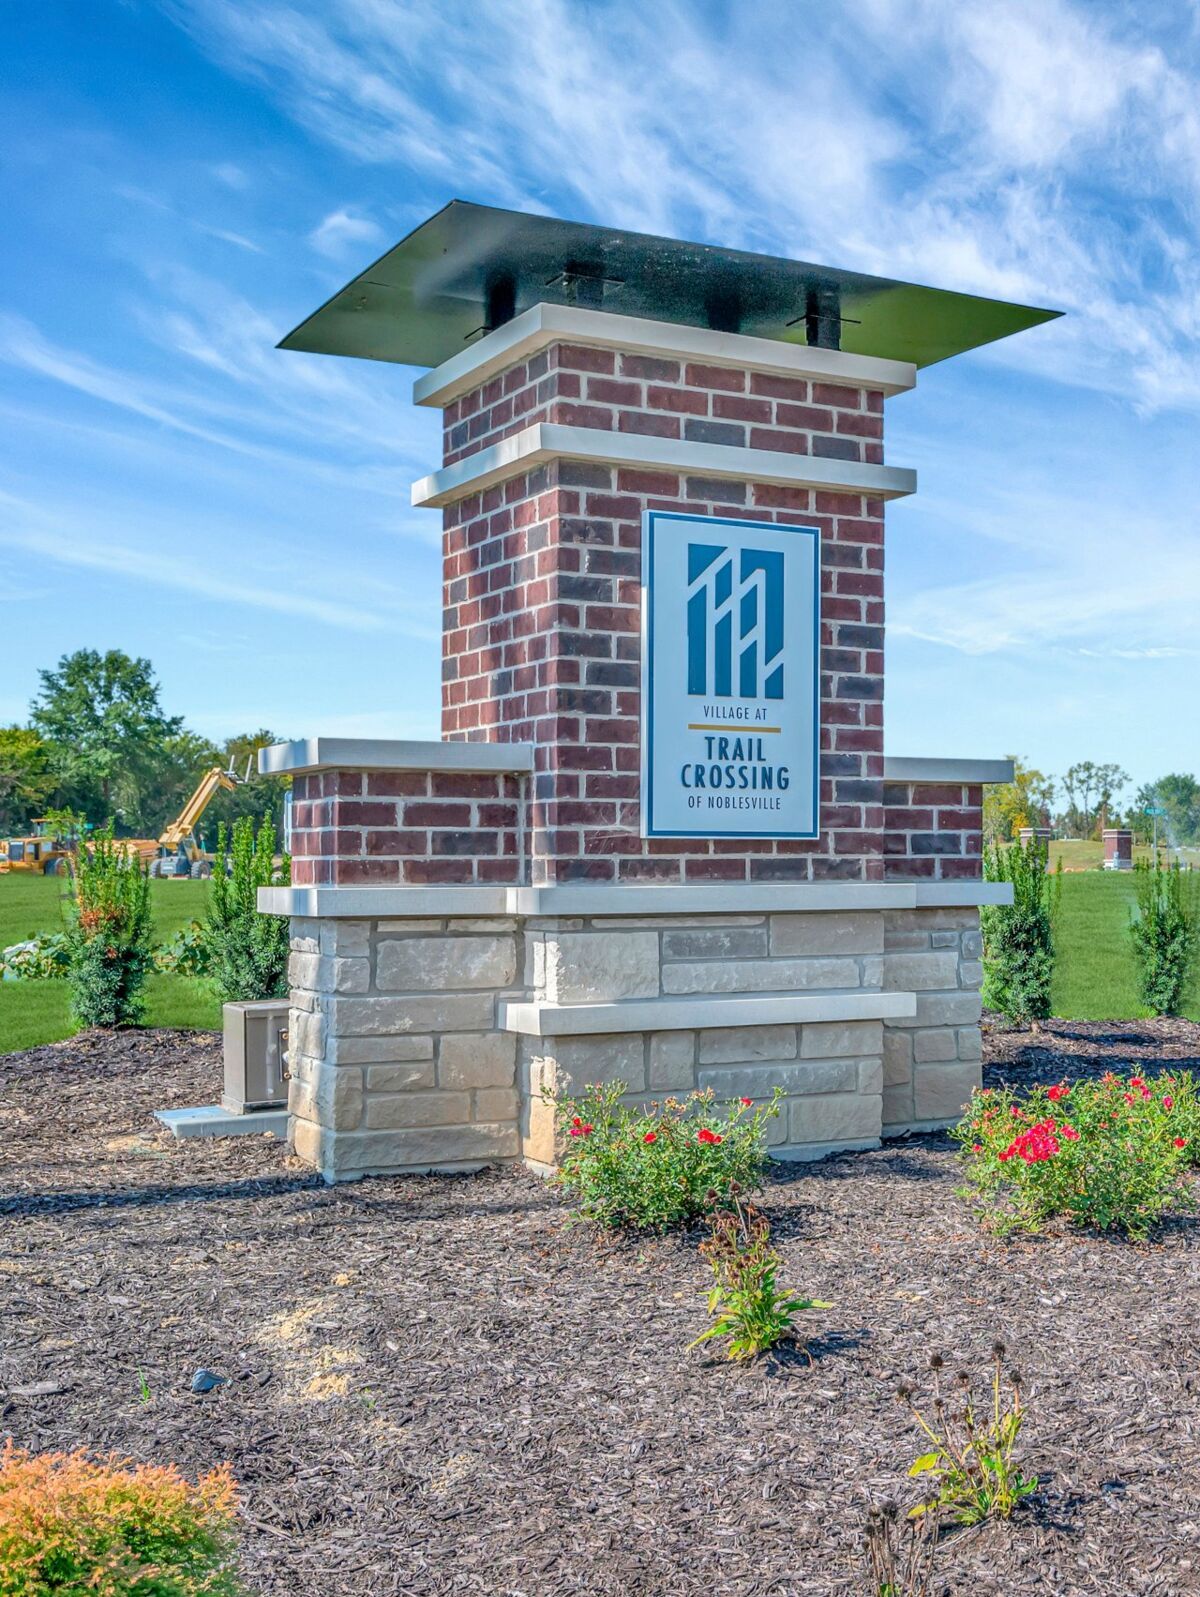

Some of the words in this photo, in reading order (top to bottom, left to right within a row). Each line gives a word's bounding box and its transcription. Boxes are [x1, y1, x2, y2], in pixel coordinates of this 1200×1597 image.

[703, 705, 750, 720] VILLAGE
[755, 708, 768, 721] AT
[704, 736, 767, 762] TRAIL
[681, 764, 789, 790] CROSSING
[688, 796, 703, 809] OF
[708, 796, 781, 811] NOBLESVILLE
